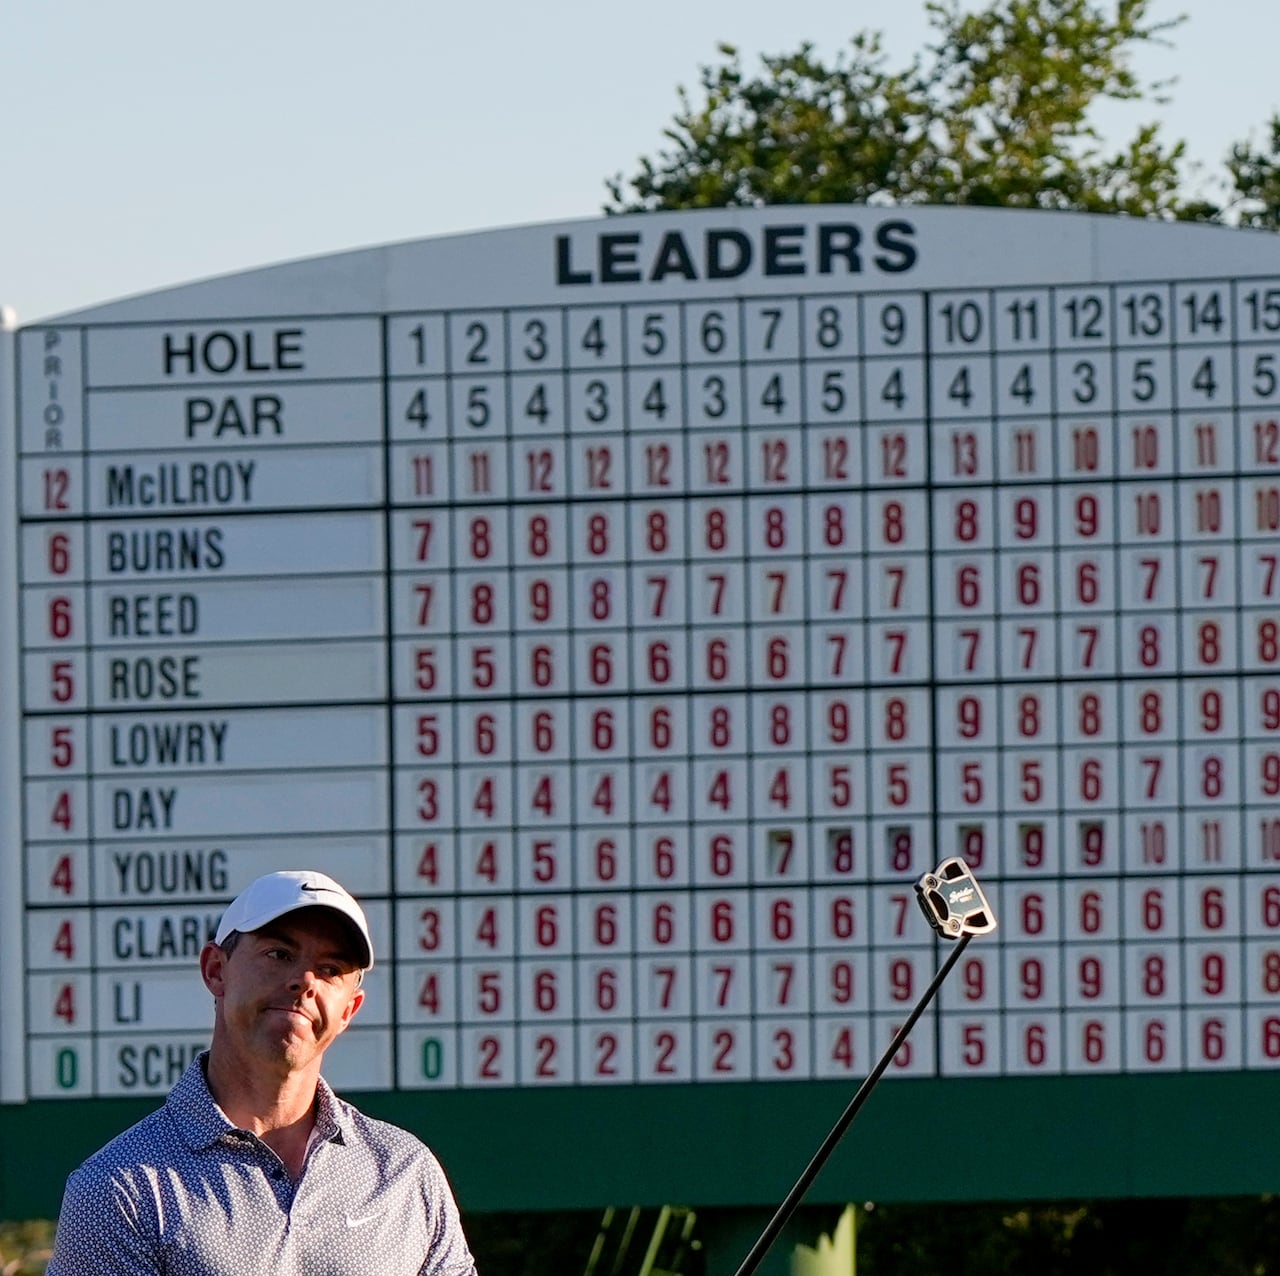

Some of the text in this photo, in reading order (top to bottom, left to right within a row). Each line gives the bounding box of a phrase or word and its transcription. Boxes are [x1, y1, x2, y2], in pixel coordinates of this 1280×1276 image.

[555, 219, 919, 286] LEADERS
[164, 329, 304, 375] HOLE
[409, 324, 426, 366] 1
[465, 321, 489, 365] 2
[524, 319, 549, 363] 3
[581, 316, 607, 358] 4
[642, 313, 667, 357] 5
[700, 310, 726, 355] 6
[759, 307, 783, 352] 7
[816, 305, 842, 350] 8
[880, 303, 907, 347] 9
[940, 300, 983, 345] 10
[1007, 299, 1038, 341] 11
[1064, 295, 1103, 339] 12
[1123, 293, 1164, 337] 13
[1183, 292, 1225, 334] 14
[43, 330, 65, 450] PRIOR
[186, 395, 283, 439] PAR
[405, 388, 431, 430] 4
[467, 385, 491, 430] 5
[525, 383, 550, 425] 4
[585, 379, 610, 425] 3
[643, 378, 668, 420] 4
[703, 375, 728, 420] 3
[761, 373, 786, 415] 4
[822, 370, 846, 414] 5
[881, 368, 907, 409] 4
[948, 365, 973, 408] 4
[1010, 364, 1035, 405] 4
[1073, 360, 1098, 405] 3
[1133, 358, 1157, 403] 5
[1191, 356, 1217, 399] 4
[1253, 353, 1278, 399] 5
[42, 468, 70, 513] 12
[107, 459, 257, 508] McILROY
[411, 453, 434, 497] 11
[527, 449, 554, 493] 12
[705, 440, 730, 485] 12
[881, 433, 907, 479] 12
[1014, 429, 1036, 473] 11
[1132, 425, 1158, 470] 10
[49, 533, 70, 576] 6
[109, 529, 225, 573] BURNS
[414, 519, 434, 562] 7
[528, 515, 551, 559] 8
[705, 507, 728, 553] 8
[883, 501, 905, 545] 8
[1014, 497, 1039, 541] 9
[1135, 491, 1161, 537] 10
[50, 597, 72, 640] 6
[109, 594, 198, 637] REED
[415, 582, 434, 626] 7
[529, 579, 553, 623] 9
[707, 571, 728, 617] 7
[886, 565, 906, 609] 7
[1017, 563, 1041, 607] 6
[1140, 557, 1162, 602] 7
[51, 661, 74, 704] 5
[111, 656, 199, 700] ROSE
[415, 648, 437, 693] 5
[530, 644, 553, 689] 6
[706, 638, 729, 683] 6
[886, 631, 907, 674] 7
[1018, 626, 1040, 670] 7
[1138, 624, 1161, 669] 8
[52, 727, 74, 768] 5
[111, 722, 227, 766] LOWRY
[416, 714, 440, 757] 5
[532, 710, 555, 753] 6
[709, 706, 732, 750] 8
[885, 697, 908, 742] 8
[1018, 693, 1041, 738] 8
[1140, 689, 1163, 735] 8
[52, 792, 73, 831] 4
[113, 789, 176, 831] DAY
[418, 778, 440, 823] 3
[532, 775, 555, 816] 4
[708, 771, 731, 810] 4
[887, 763, 910, 808] 5
[1020, 759, 1043, 805] 5
[1142, 755, 1164, 800] 7
[52, 855, 74, 894] 4
[114, 850, 227, 895] YOUNG
[417, 843, 439, 885] 4
[533, 840, 557, 884] 5
[709, 834, 734, 878] 6
[890, 831, 913, 873] 8
[1140, 821, 1166, 865] 10
[54, 920, 75, 960] 4
[419, 908, 441, 953] 3
[535, 905, 558, 949] 6
[710, 899, 734, 944] 6
[891, 894, 910, 937] 7
[1020, 892, 1045, 936] 6
[1141, 888, 1165, 933] 6
[55, 984, 75, 1023] 4
[113, 981, 142, 1025] LI
[419, 974, 441, 1015] 4
[533, 969, 558, 1014] 6
[713, 965, 735, 1008] 7
[890, 959, 914, 1002] 9
[1019, 958, 1044, 1002] 9
[1142, 954, 1167, 999] 8
[57, 1048, 80, 1090] 0
[421, 1038, 445, 1081] 0
[536, 1034, 558, 1079] 2
[712, 1029, 736, 1074] 2
[1023, 1023, 1047, 1067] 6
[1144, 1019, 1166, 1064] 6
